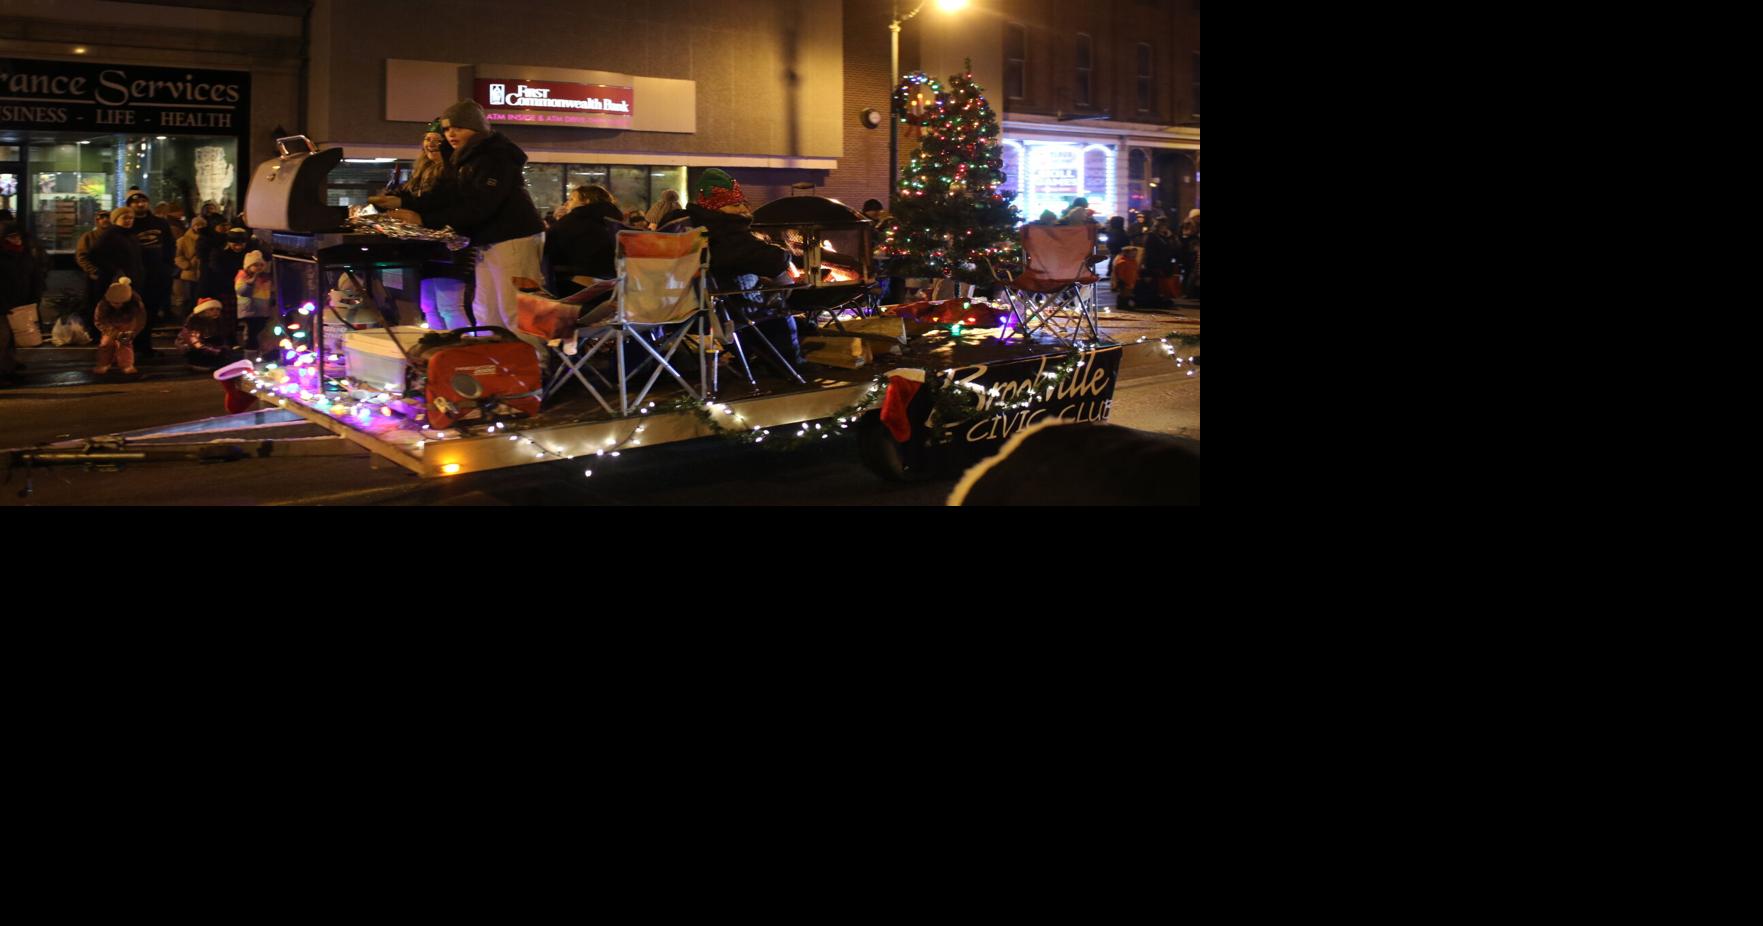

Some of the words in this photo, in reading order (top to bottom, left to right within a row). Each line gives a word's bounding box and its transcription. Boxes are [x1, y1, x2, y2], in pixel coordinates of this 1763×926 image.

[95, 70, 240, 106] Services
[0, 105, 67, 124] SINESS
[96, 109, 135, 126] LIFE
[160, 111, 232, 128] HEALTH
[506, 93, 602, 110] Commonwealth
[603, 98, 630, 112] Bank
[486, 113, 506, 121] ATM
[507, 113, 536, 122] INSIDE
[924, 350, 1109, 428] Brooille
[966, 408, 1047, 442] CIVIC
